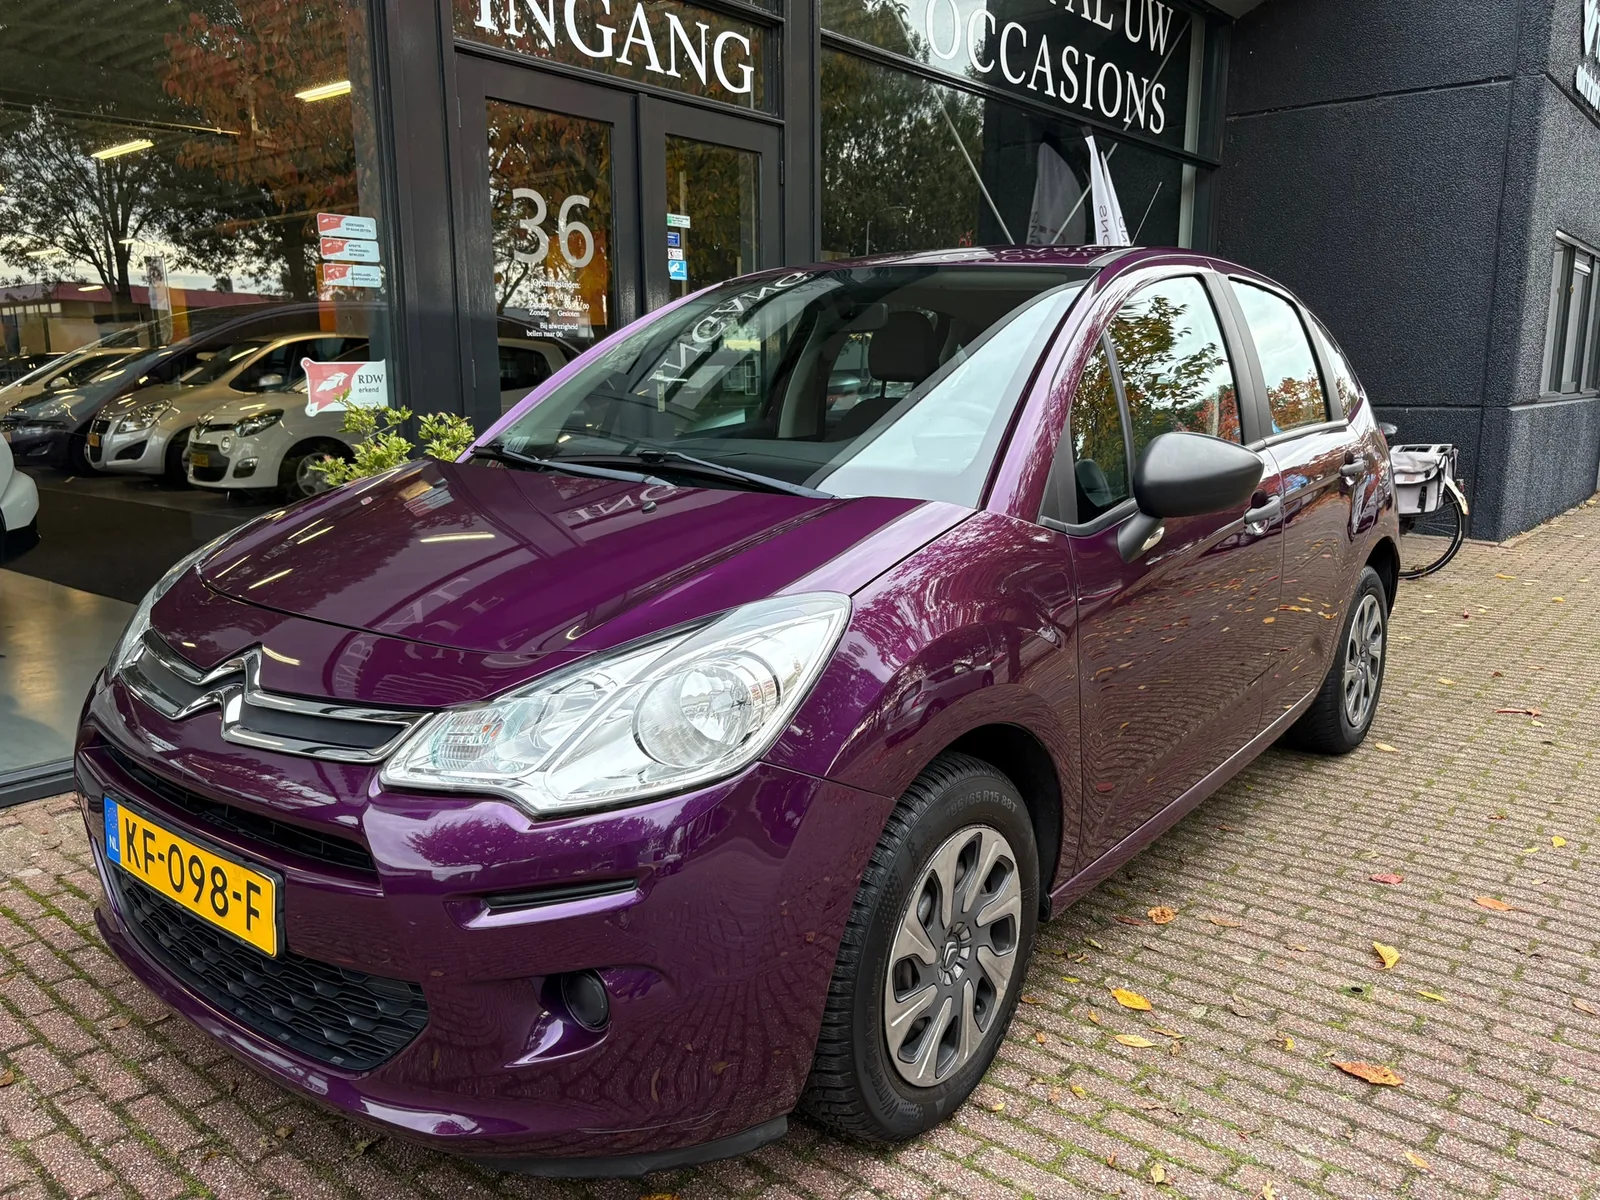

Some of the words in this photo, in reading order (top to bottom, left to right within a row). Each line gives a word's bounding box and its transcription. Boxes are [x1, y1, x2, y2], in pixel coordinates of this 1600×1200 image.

[1125, 0, 1174, 56] UW
[925, 0, 1166, 135] OCCASIONS
[512, 187, 595, 268] 36
[529, 309, 550, 318] Zondag
[358, 374, 384, 384] RDW
[358, 386, 379, 394] erkend
[983, 789, 1000, 803] R15
[108, 834, 119, 852] NL
[125, 817, 262, 932] KF-098-F
